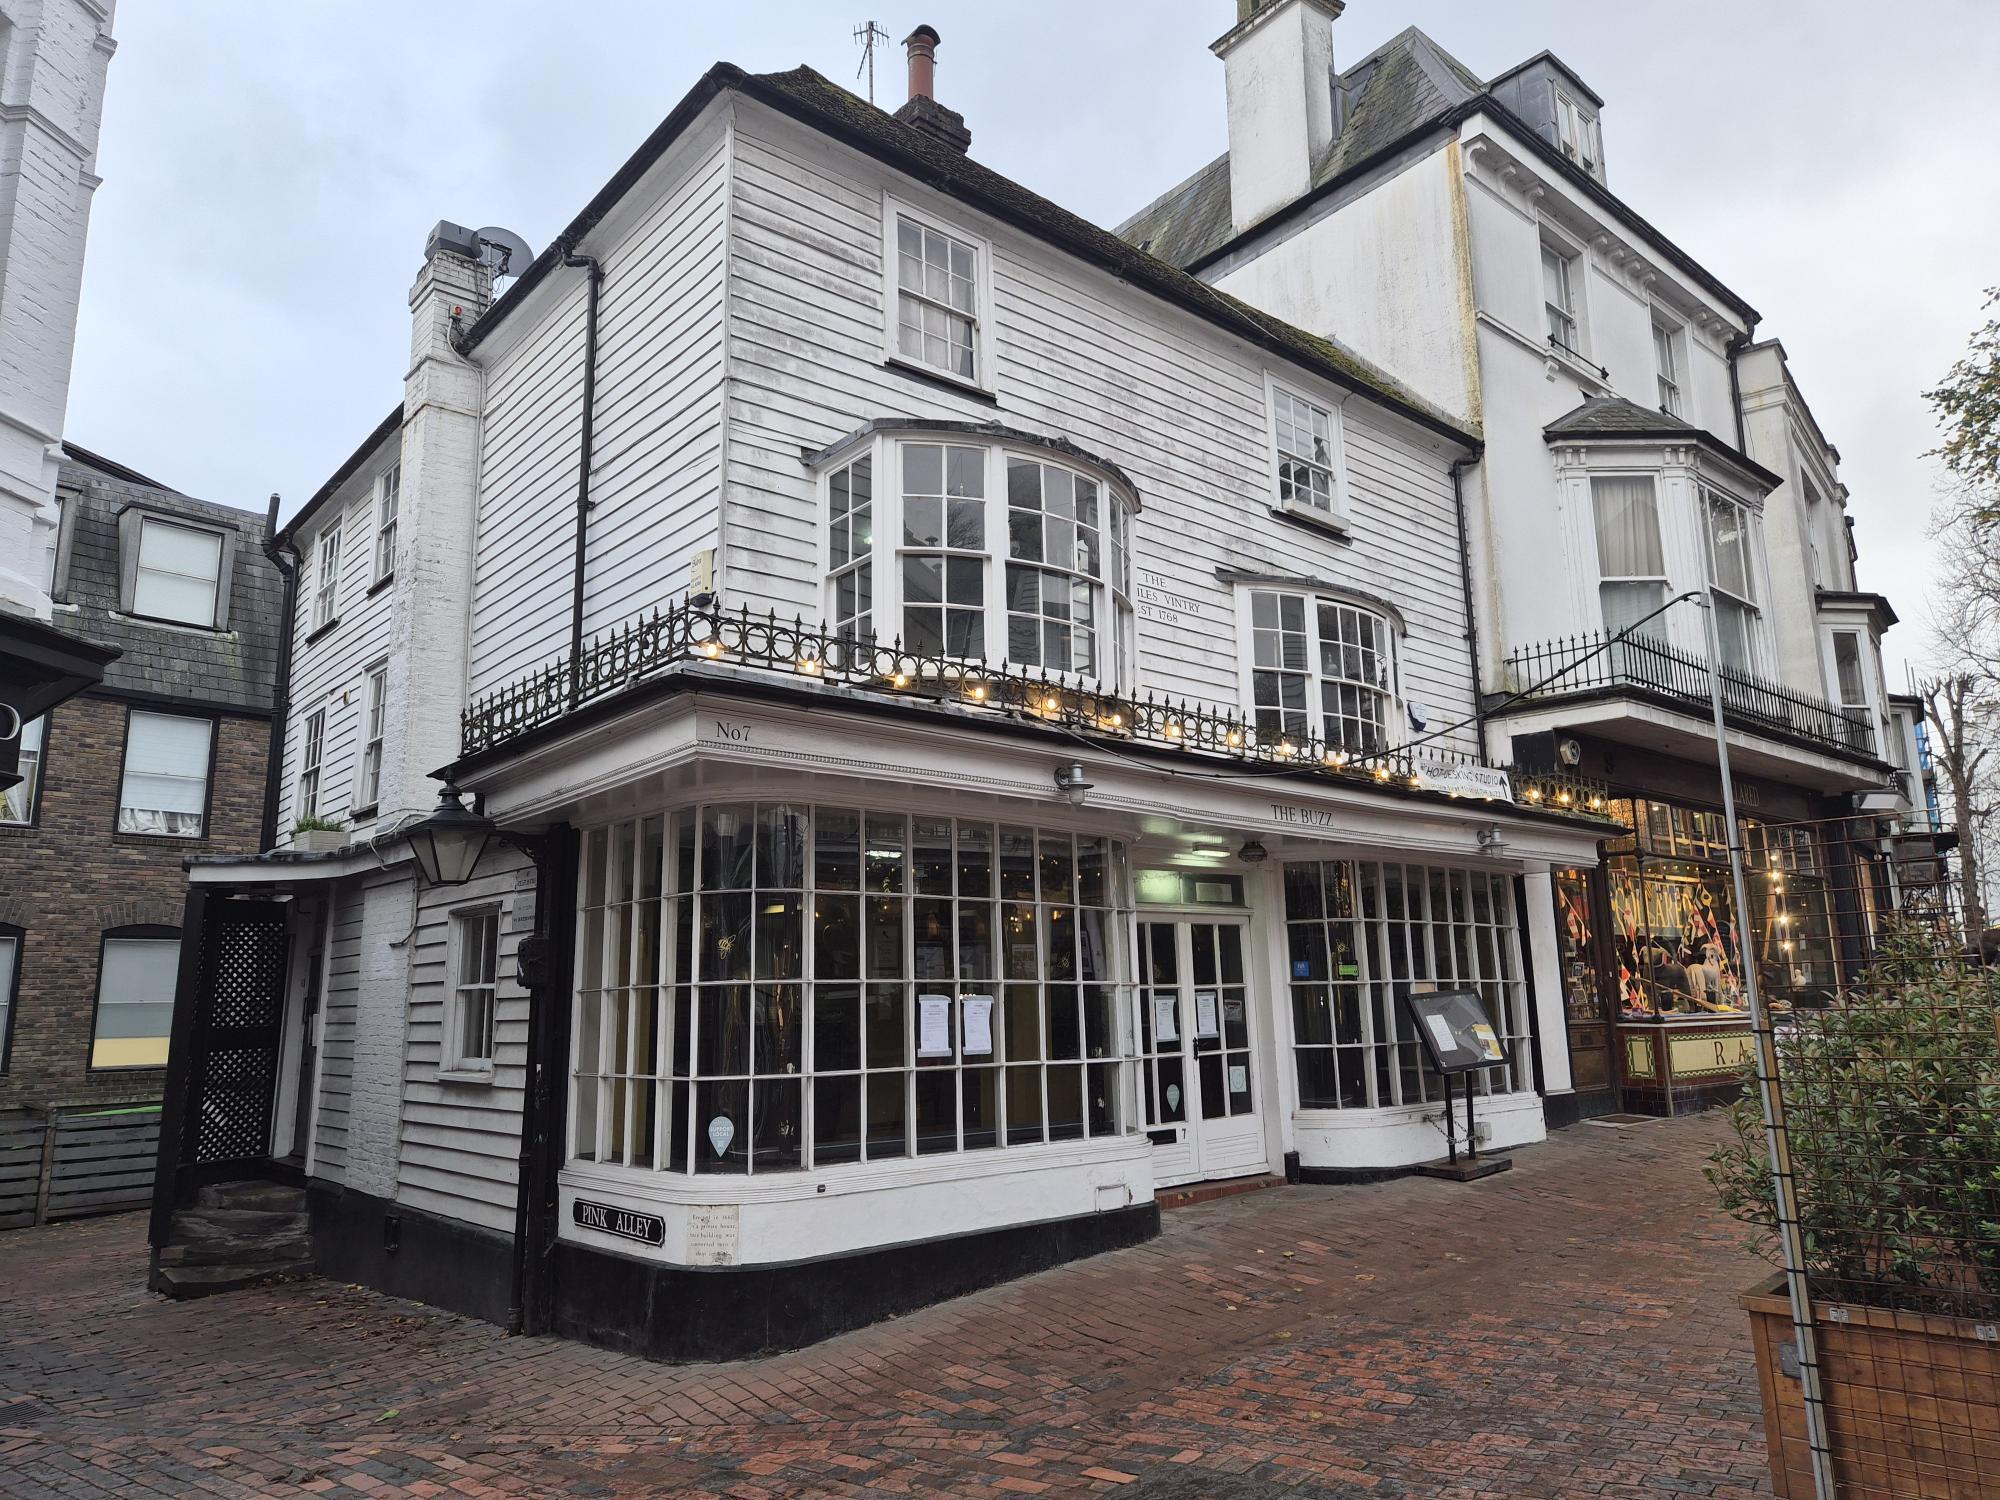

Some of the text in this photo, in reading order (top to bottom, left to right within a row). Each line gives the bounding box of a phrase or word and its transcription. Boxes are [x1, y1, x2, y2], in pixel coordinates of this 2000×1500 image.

[1143, 573, 1166, 588] THE
[1137, 588, 1200, 613] ILES VINTRY
[1138, 604, 1178, 623] ST 1768
[716, 721, 751, 741] No7
[1475, 773, 1498, 785] STUDIO
[1271, 804, 1333, 827] THE BUZZ
[1182, 1128, 1187, 1139] 7
[582, 1204, 651, 1238] PINK ALLEY
